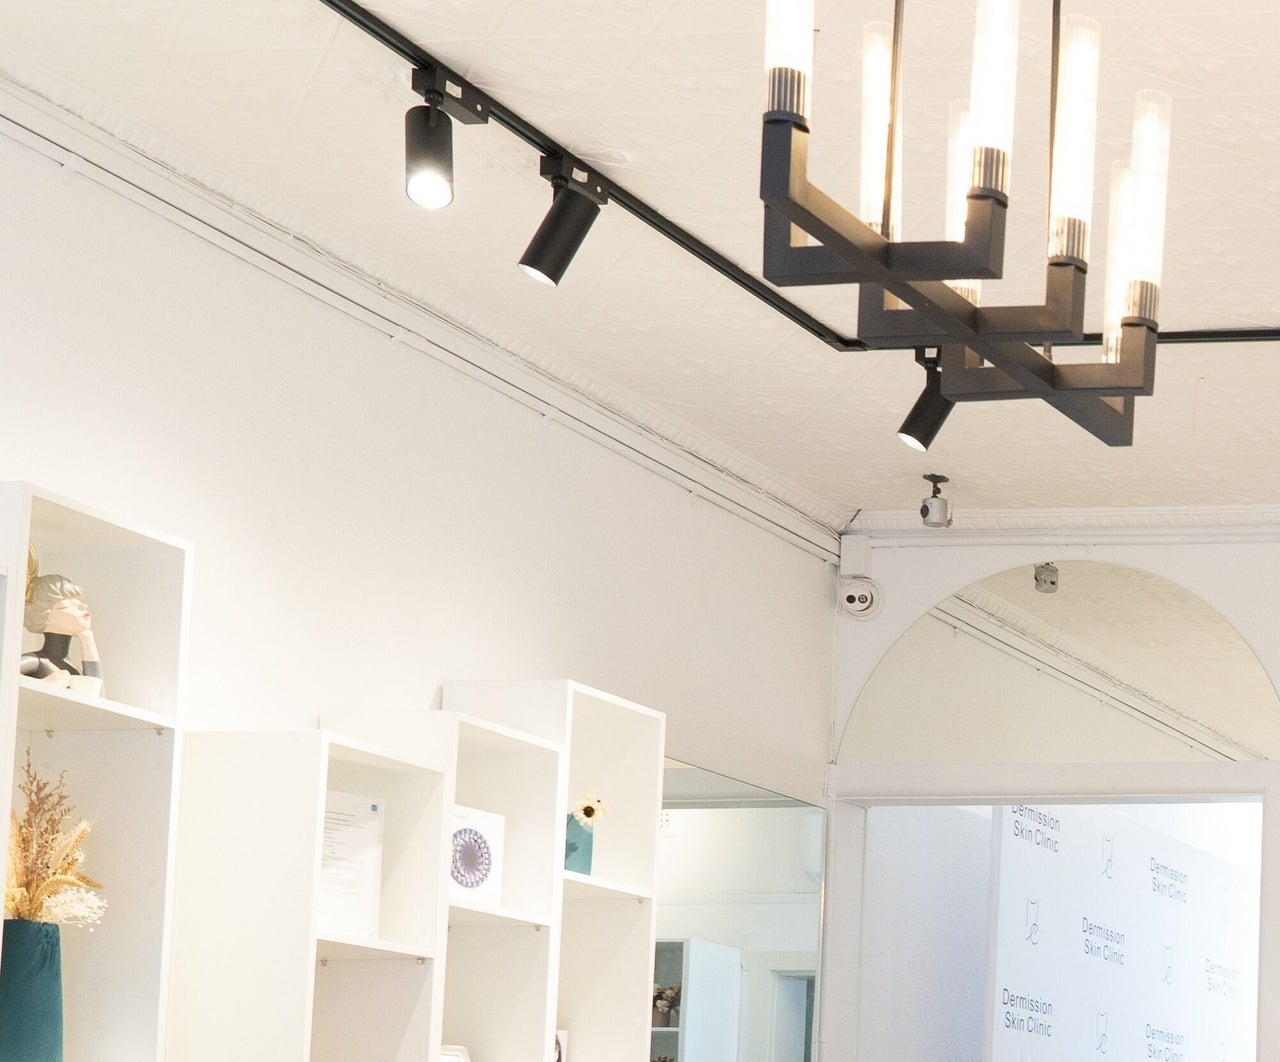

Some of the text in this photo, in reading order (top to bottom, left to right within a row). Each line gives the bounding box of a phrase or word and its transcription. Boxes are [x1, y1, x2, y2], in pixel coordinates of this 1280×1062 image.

[1011, 804, 1060, 832] Dermission
[1013, 820, 1059, 853] Skin Clinic
[1082, 917, 1125, 946] Dermission
[1084, 938, 1125, 966] Skin Clinic
[1002, 987, 1053, 1015] Dermission
[1004, 1011, 1052, 1037] Skin Clinic
[1145, 1023, 1184, 1046] Dermission
[1147, 1043, 1163, 1060] Skin
